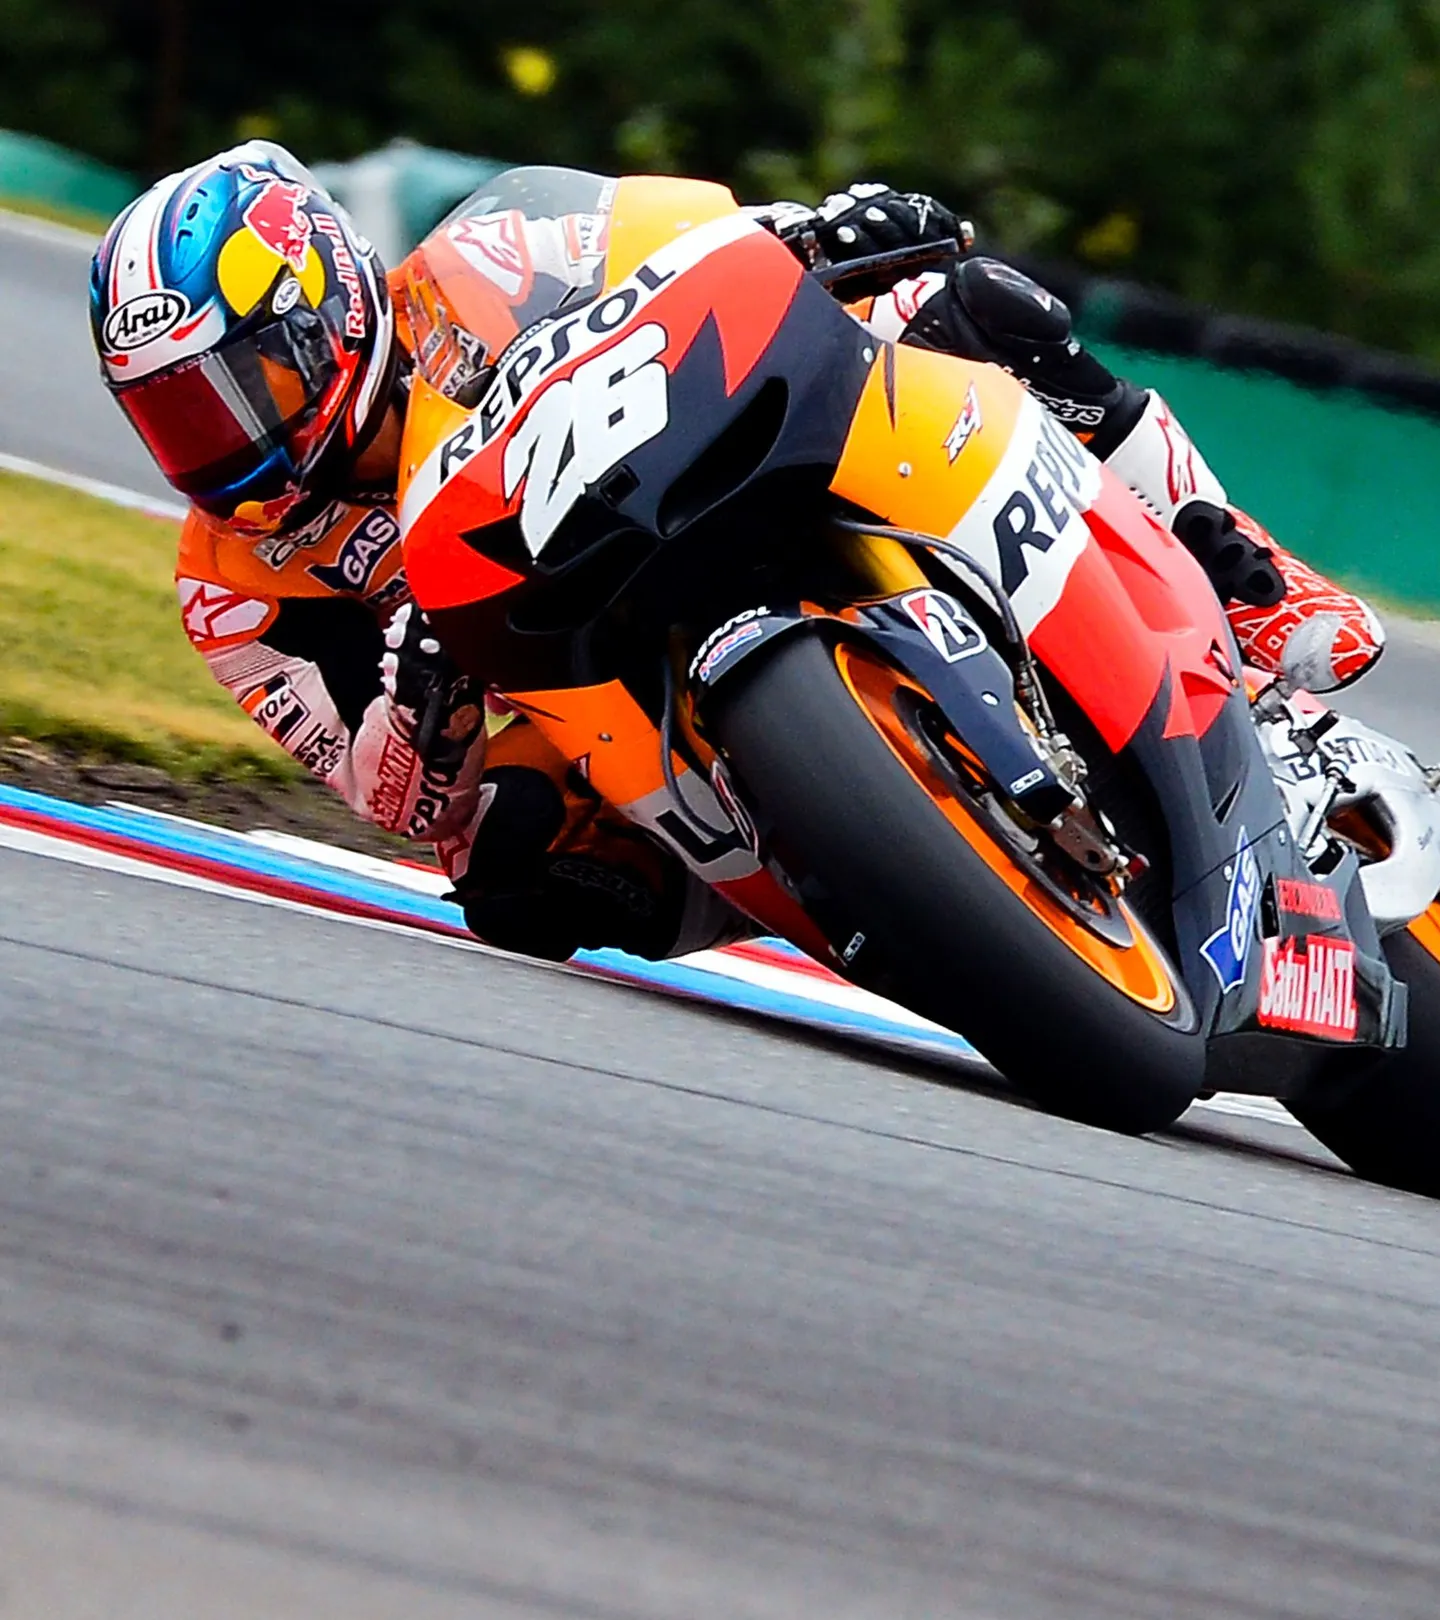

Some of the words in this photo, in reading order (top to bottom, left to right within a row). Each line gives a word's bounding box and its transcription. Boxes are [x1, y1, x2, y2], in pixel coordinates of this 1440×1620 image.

[111, 299, 173, 342] Arai
[440, 263, 676, 485] REPSOL
[502, 323, 669, 557] 26
[343, 516, 396, 585] GAS
